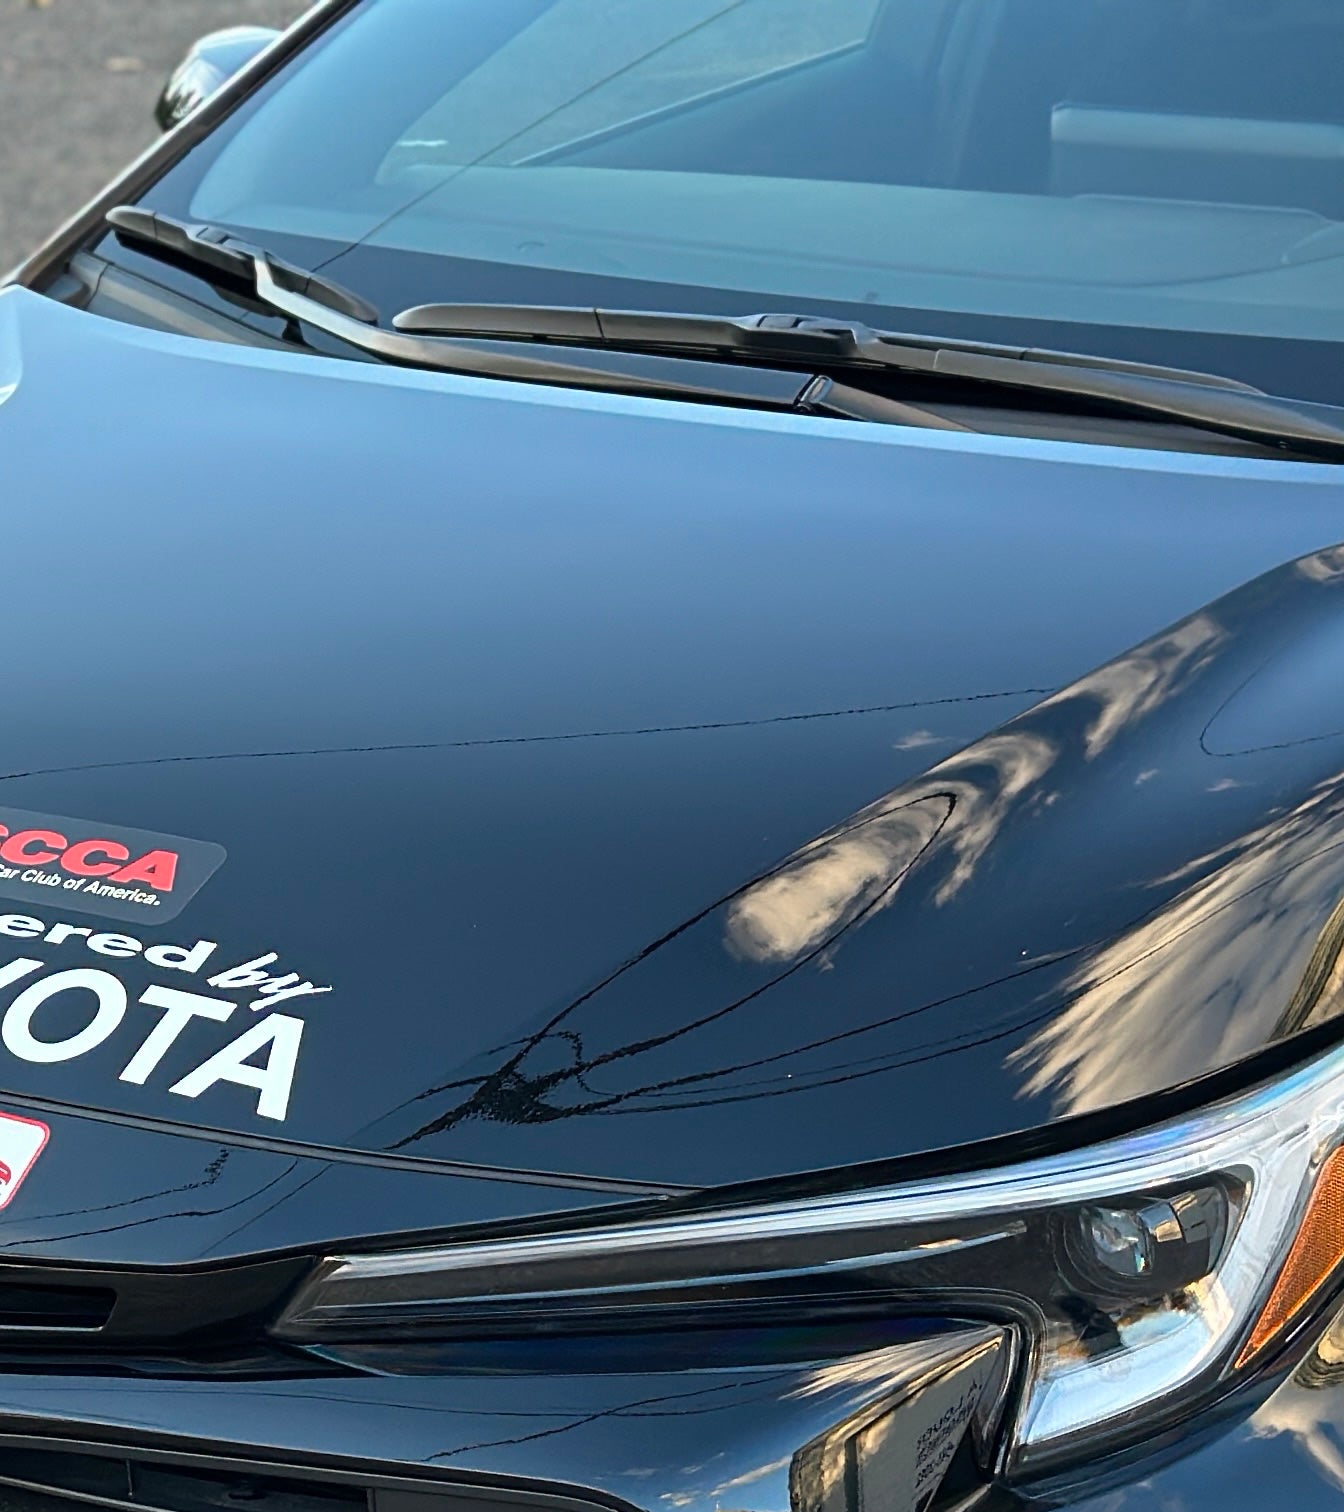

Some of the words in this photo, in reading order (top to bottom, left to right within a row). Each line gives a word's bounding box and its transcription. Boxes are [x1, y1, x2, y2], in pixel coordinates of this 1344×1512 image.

[20, 865, 62, 887] Club
[62, 876, 83, 891] of
[206, 951, 333, 1011] by
